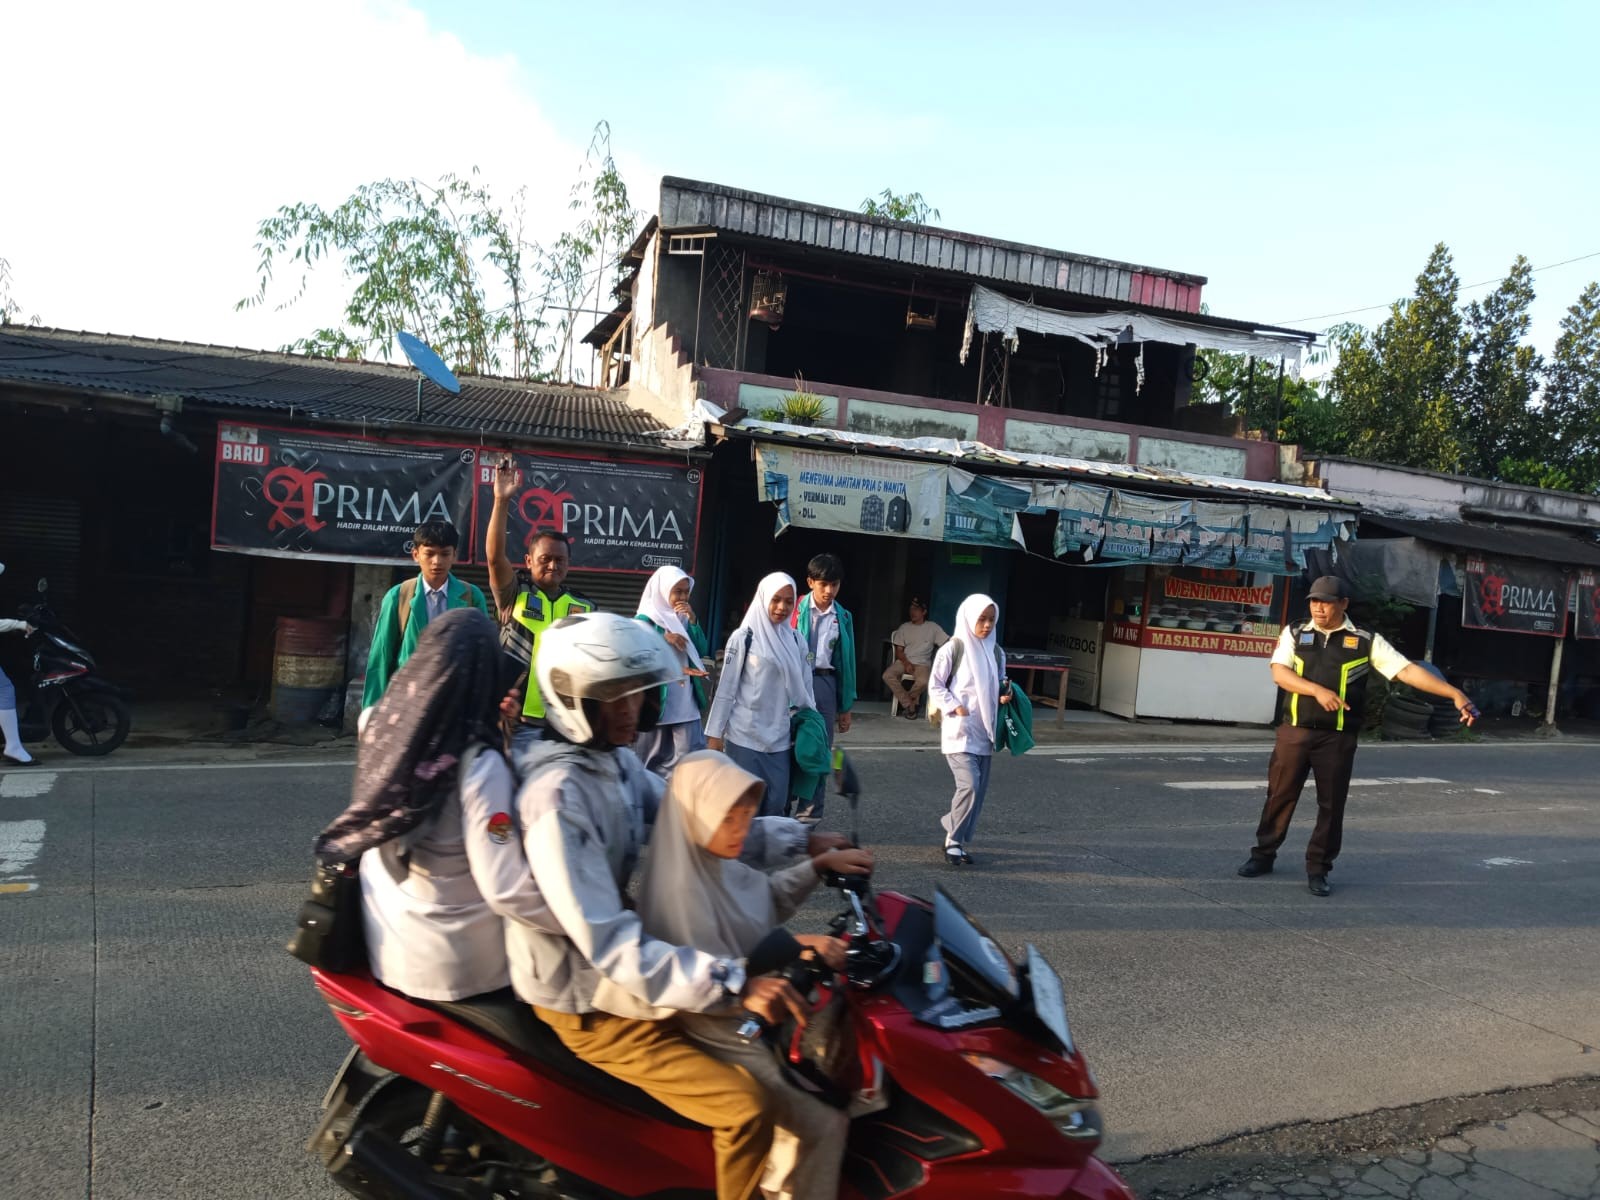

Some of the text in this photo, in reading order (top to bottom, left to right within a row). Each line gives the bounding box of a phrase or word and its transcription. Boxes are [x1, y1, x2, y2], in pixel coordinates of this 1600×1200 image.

[221, 444, 265, 464] BARU
[792, 449, 853, 473] MINANG
[799, 471, 834, 487] MENERIMA
[834, 475, 862, 489] JAHITAN
[862, 477, 876, 491] PRIA
[883, 480, 906, 495] WANITA
[336, 521, 419, 534] HADIR DALAM KEMAS
[584, 537, 684, 551] HADIR DALAM KEMASAN KERTAS
[1151, 631, 1273, 655] MASAKAN PADANG
